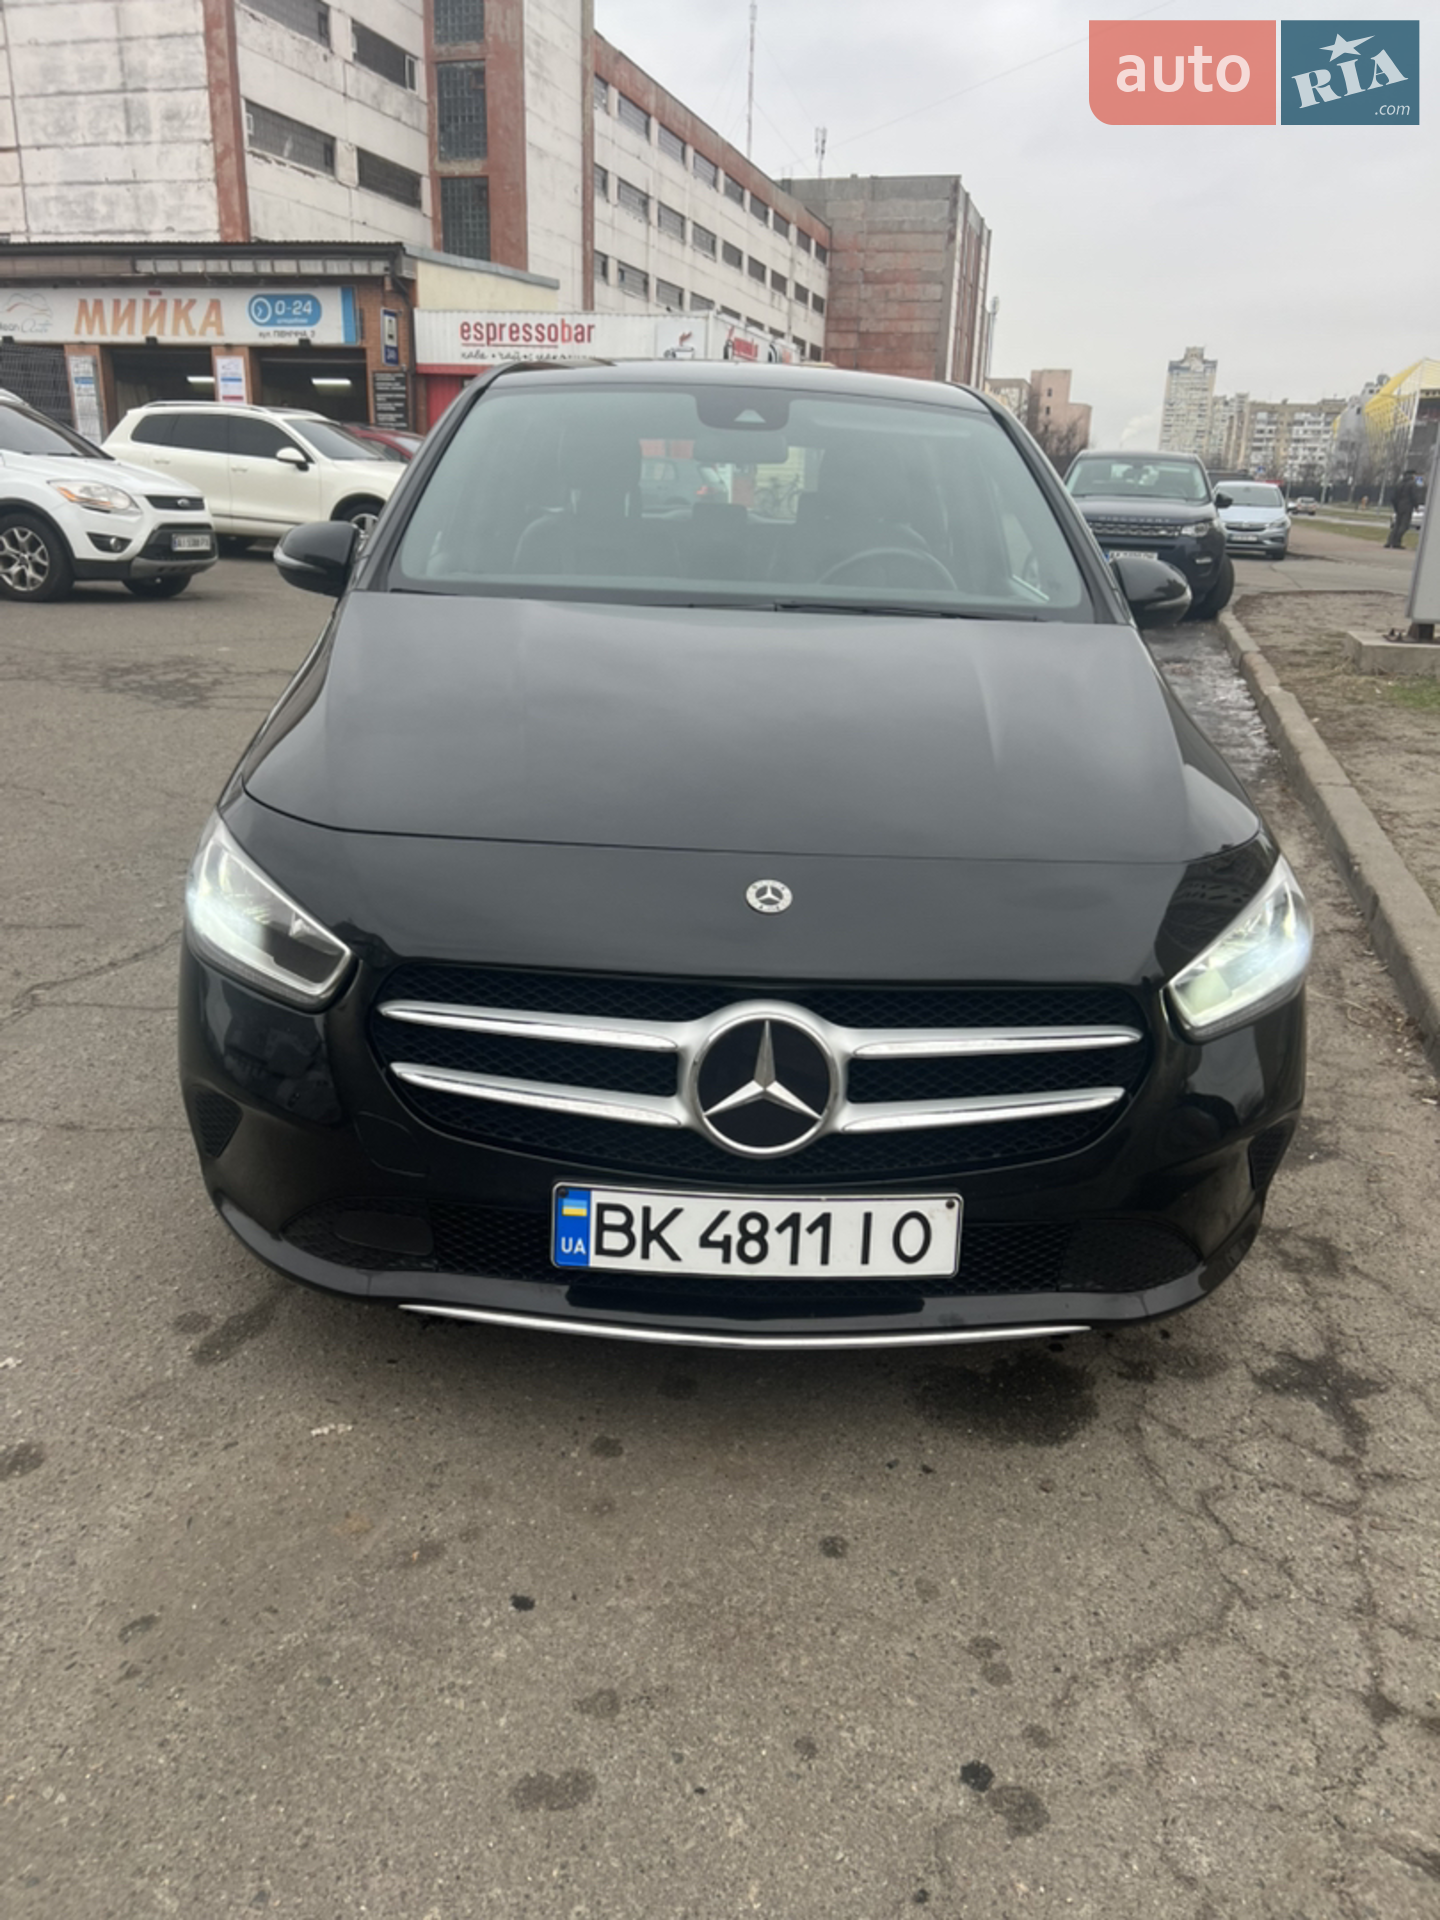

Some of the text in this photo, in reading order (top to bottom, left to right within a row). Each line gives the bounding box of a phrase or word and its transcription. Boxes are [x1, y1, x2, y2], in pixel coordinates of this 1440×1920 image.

[74, 290, 225, 336] МИЙКА
[274, 300, 313, 315] 0-24
[460, 317, 596, 346] espressobar
[561, 1237, 587, 1255] UA
[594, 1202, 684, 1262] BK
[699, 1209, 832, 1265] 4811
